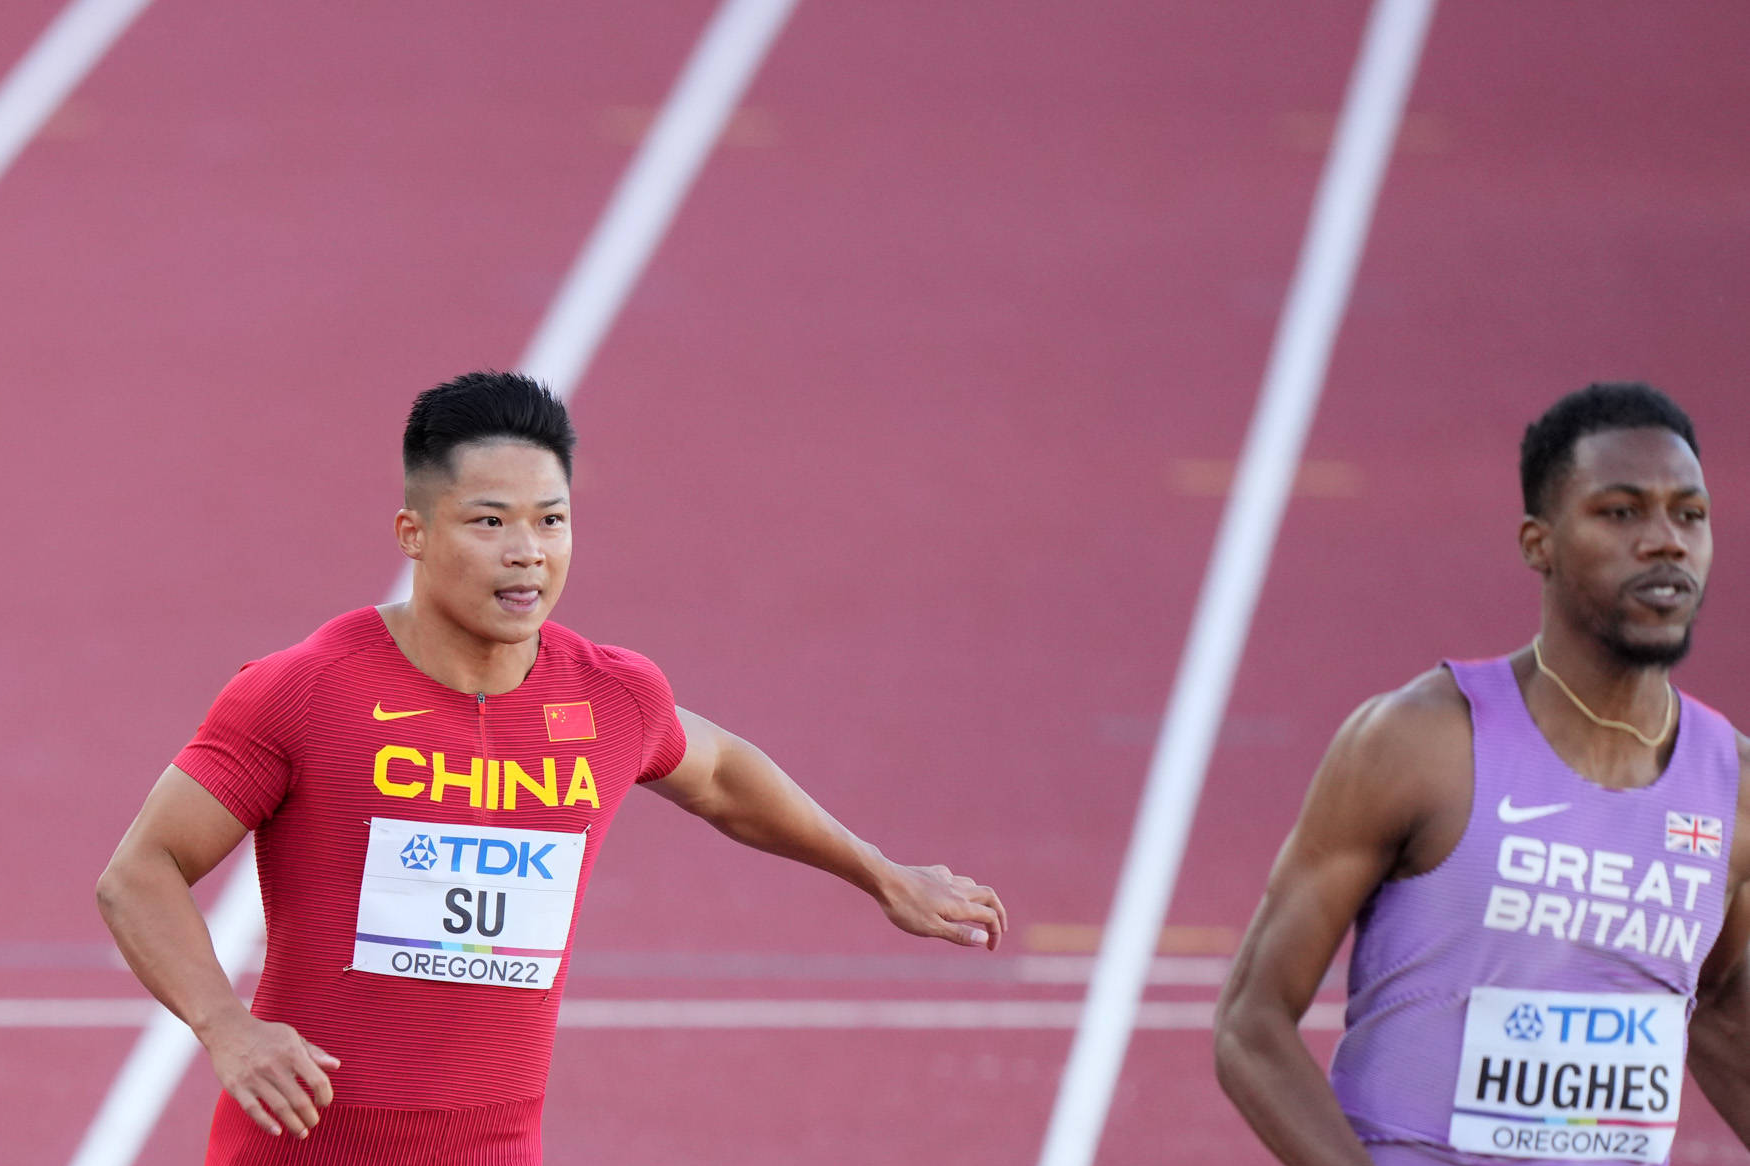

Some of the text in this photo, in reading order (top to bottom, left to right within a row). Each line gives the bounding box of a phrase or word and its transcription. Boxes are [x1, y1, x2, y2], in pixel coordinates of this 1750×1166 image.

[373, 745, 600, 809] CHINA
[440, 836, 557, 880] TDK
[1497, 835, 1711, 911] GREAT
[443, 888, 507, 937] SU
[1483, 885, 1701, 964] BRITAIN
[391, 951, 539, 984] OREGON22
[1547, 1005, 1659, 1046] TDK
[1476, 1056, 1670, 1113] HUGHES
[1492, 1126, 1650, 1156] OREGON22
